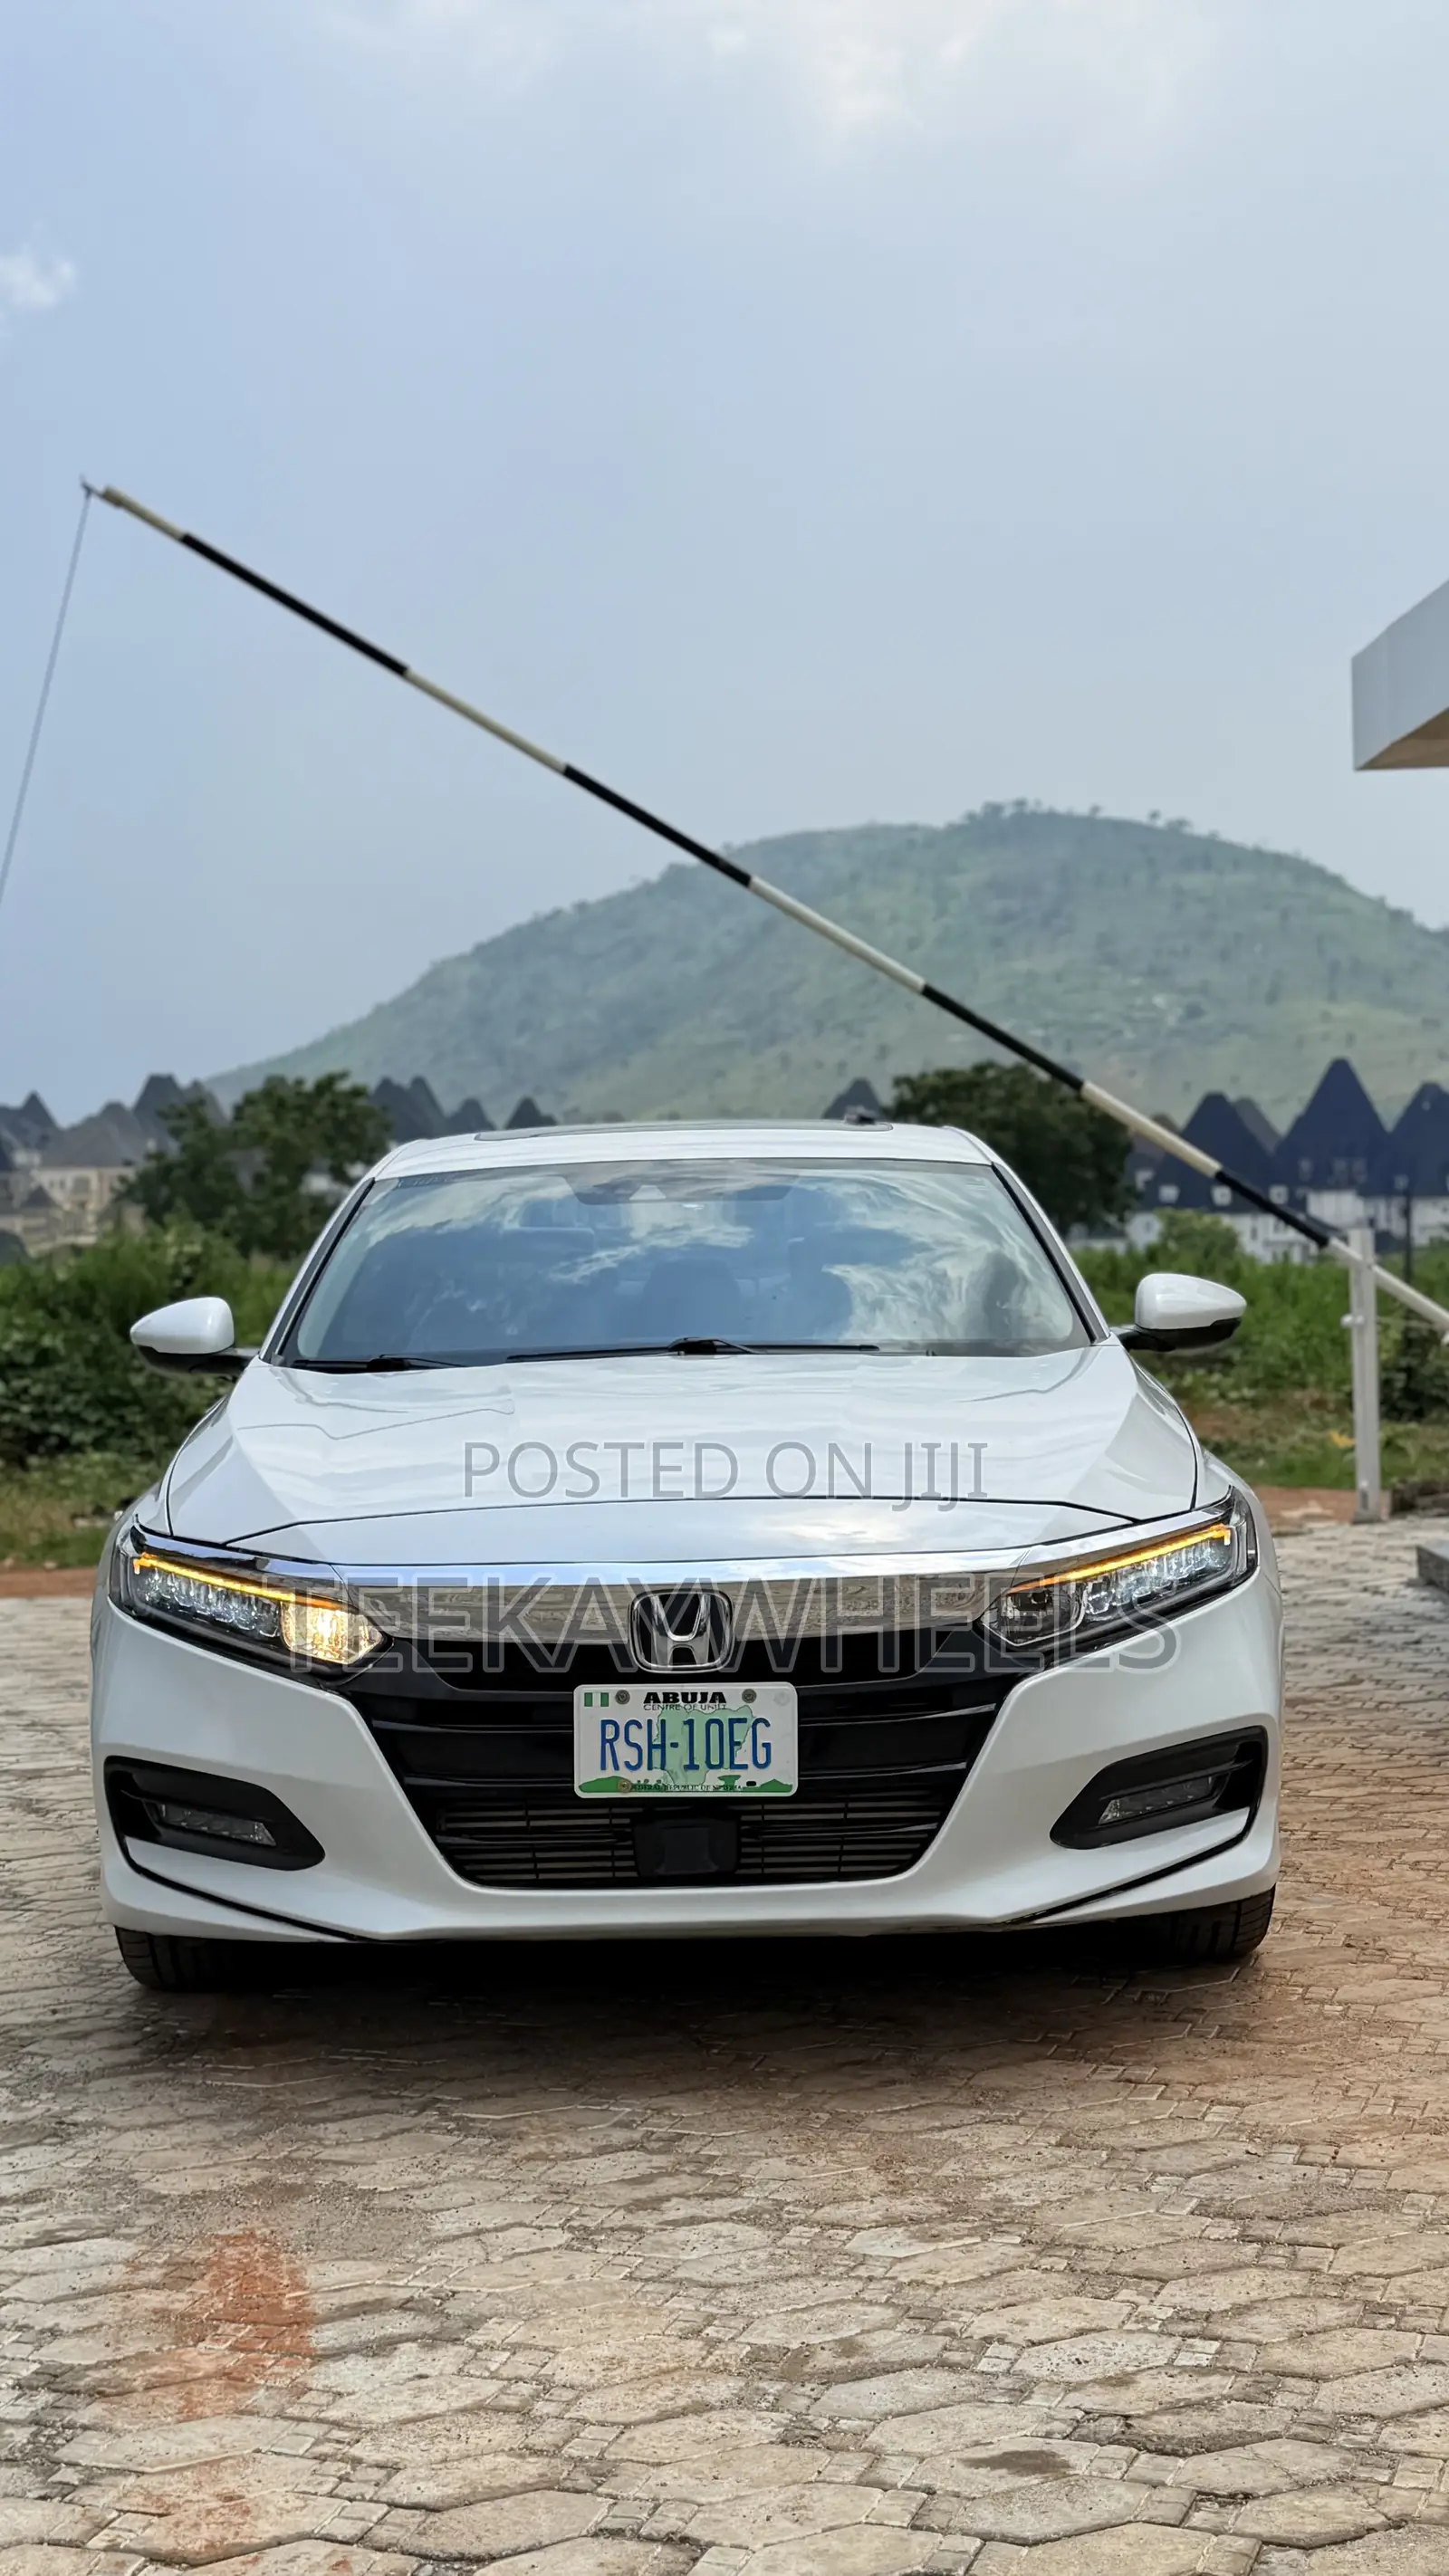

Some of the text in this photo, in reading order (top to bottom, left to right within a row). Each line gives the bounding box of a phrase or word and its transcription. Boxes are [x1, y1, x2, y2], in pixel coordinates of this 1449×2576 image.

[643, 1691, 727, 1703] ABUJA
[643, 1703, 681, 1711] CENTRE
[600, 1718, 772, 1771] RSH-10EG
